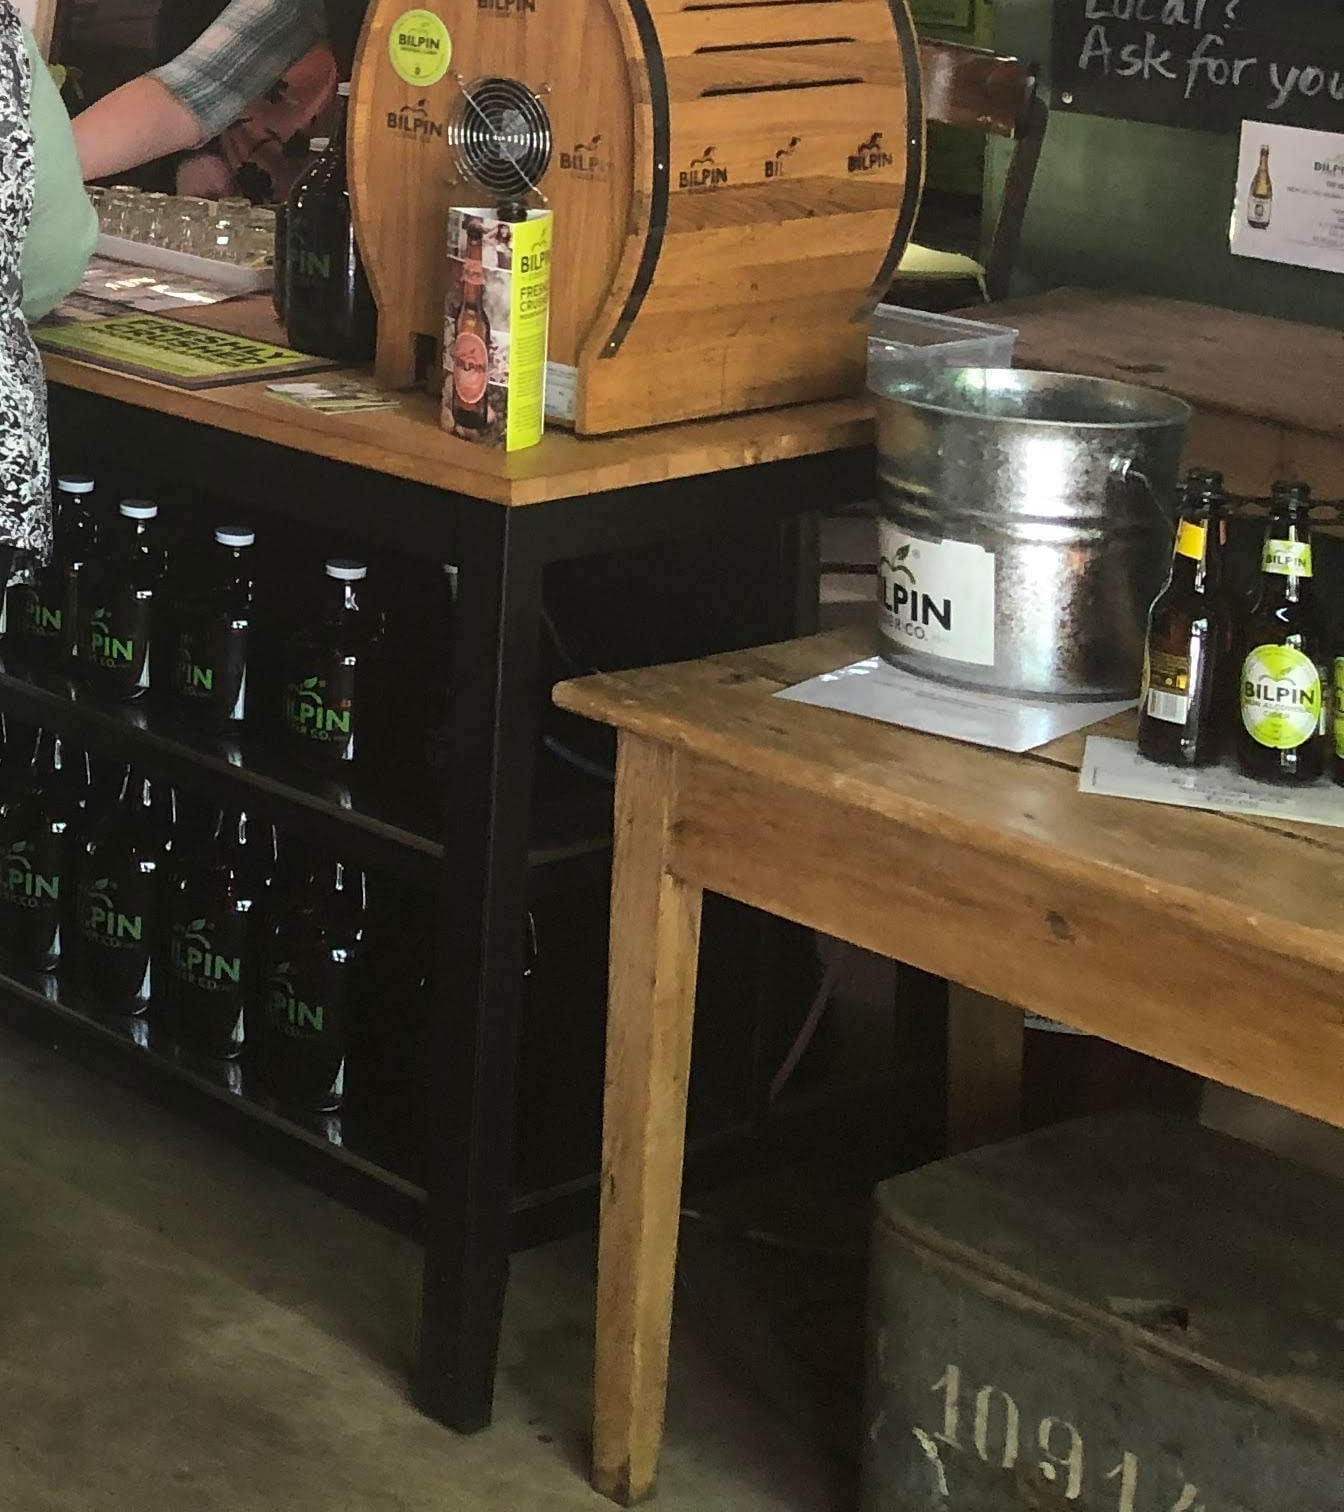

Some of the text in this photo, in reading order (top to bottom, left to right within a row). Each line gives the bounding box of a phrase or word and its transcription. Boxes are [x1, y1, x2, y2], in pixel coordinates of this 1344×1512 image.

[398, 33, 441, 50] BILPIN
[1078, 25, 1176, 79] Ask
[1184, 34, 1257, 99] for
[386, 112, 443, 138] BILPIN
[847, 150, 894, 174] BILPIN
[678, 166, 728, 189] BILPIN
[104, 322, 267, 366] CRUSHED
[126, 318, 302, 360] FRESHLY
[1244, 680, 1315, 705] BILPIN
